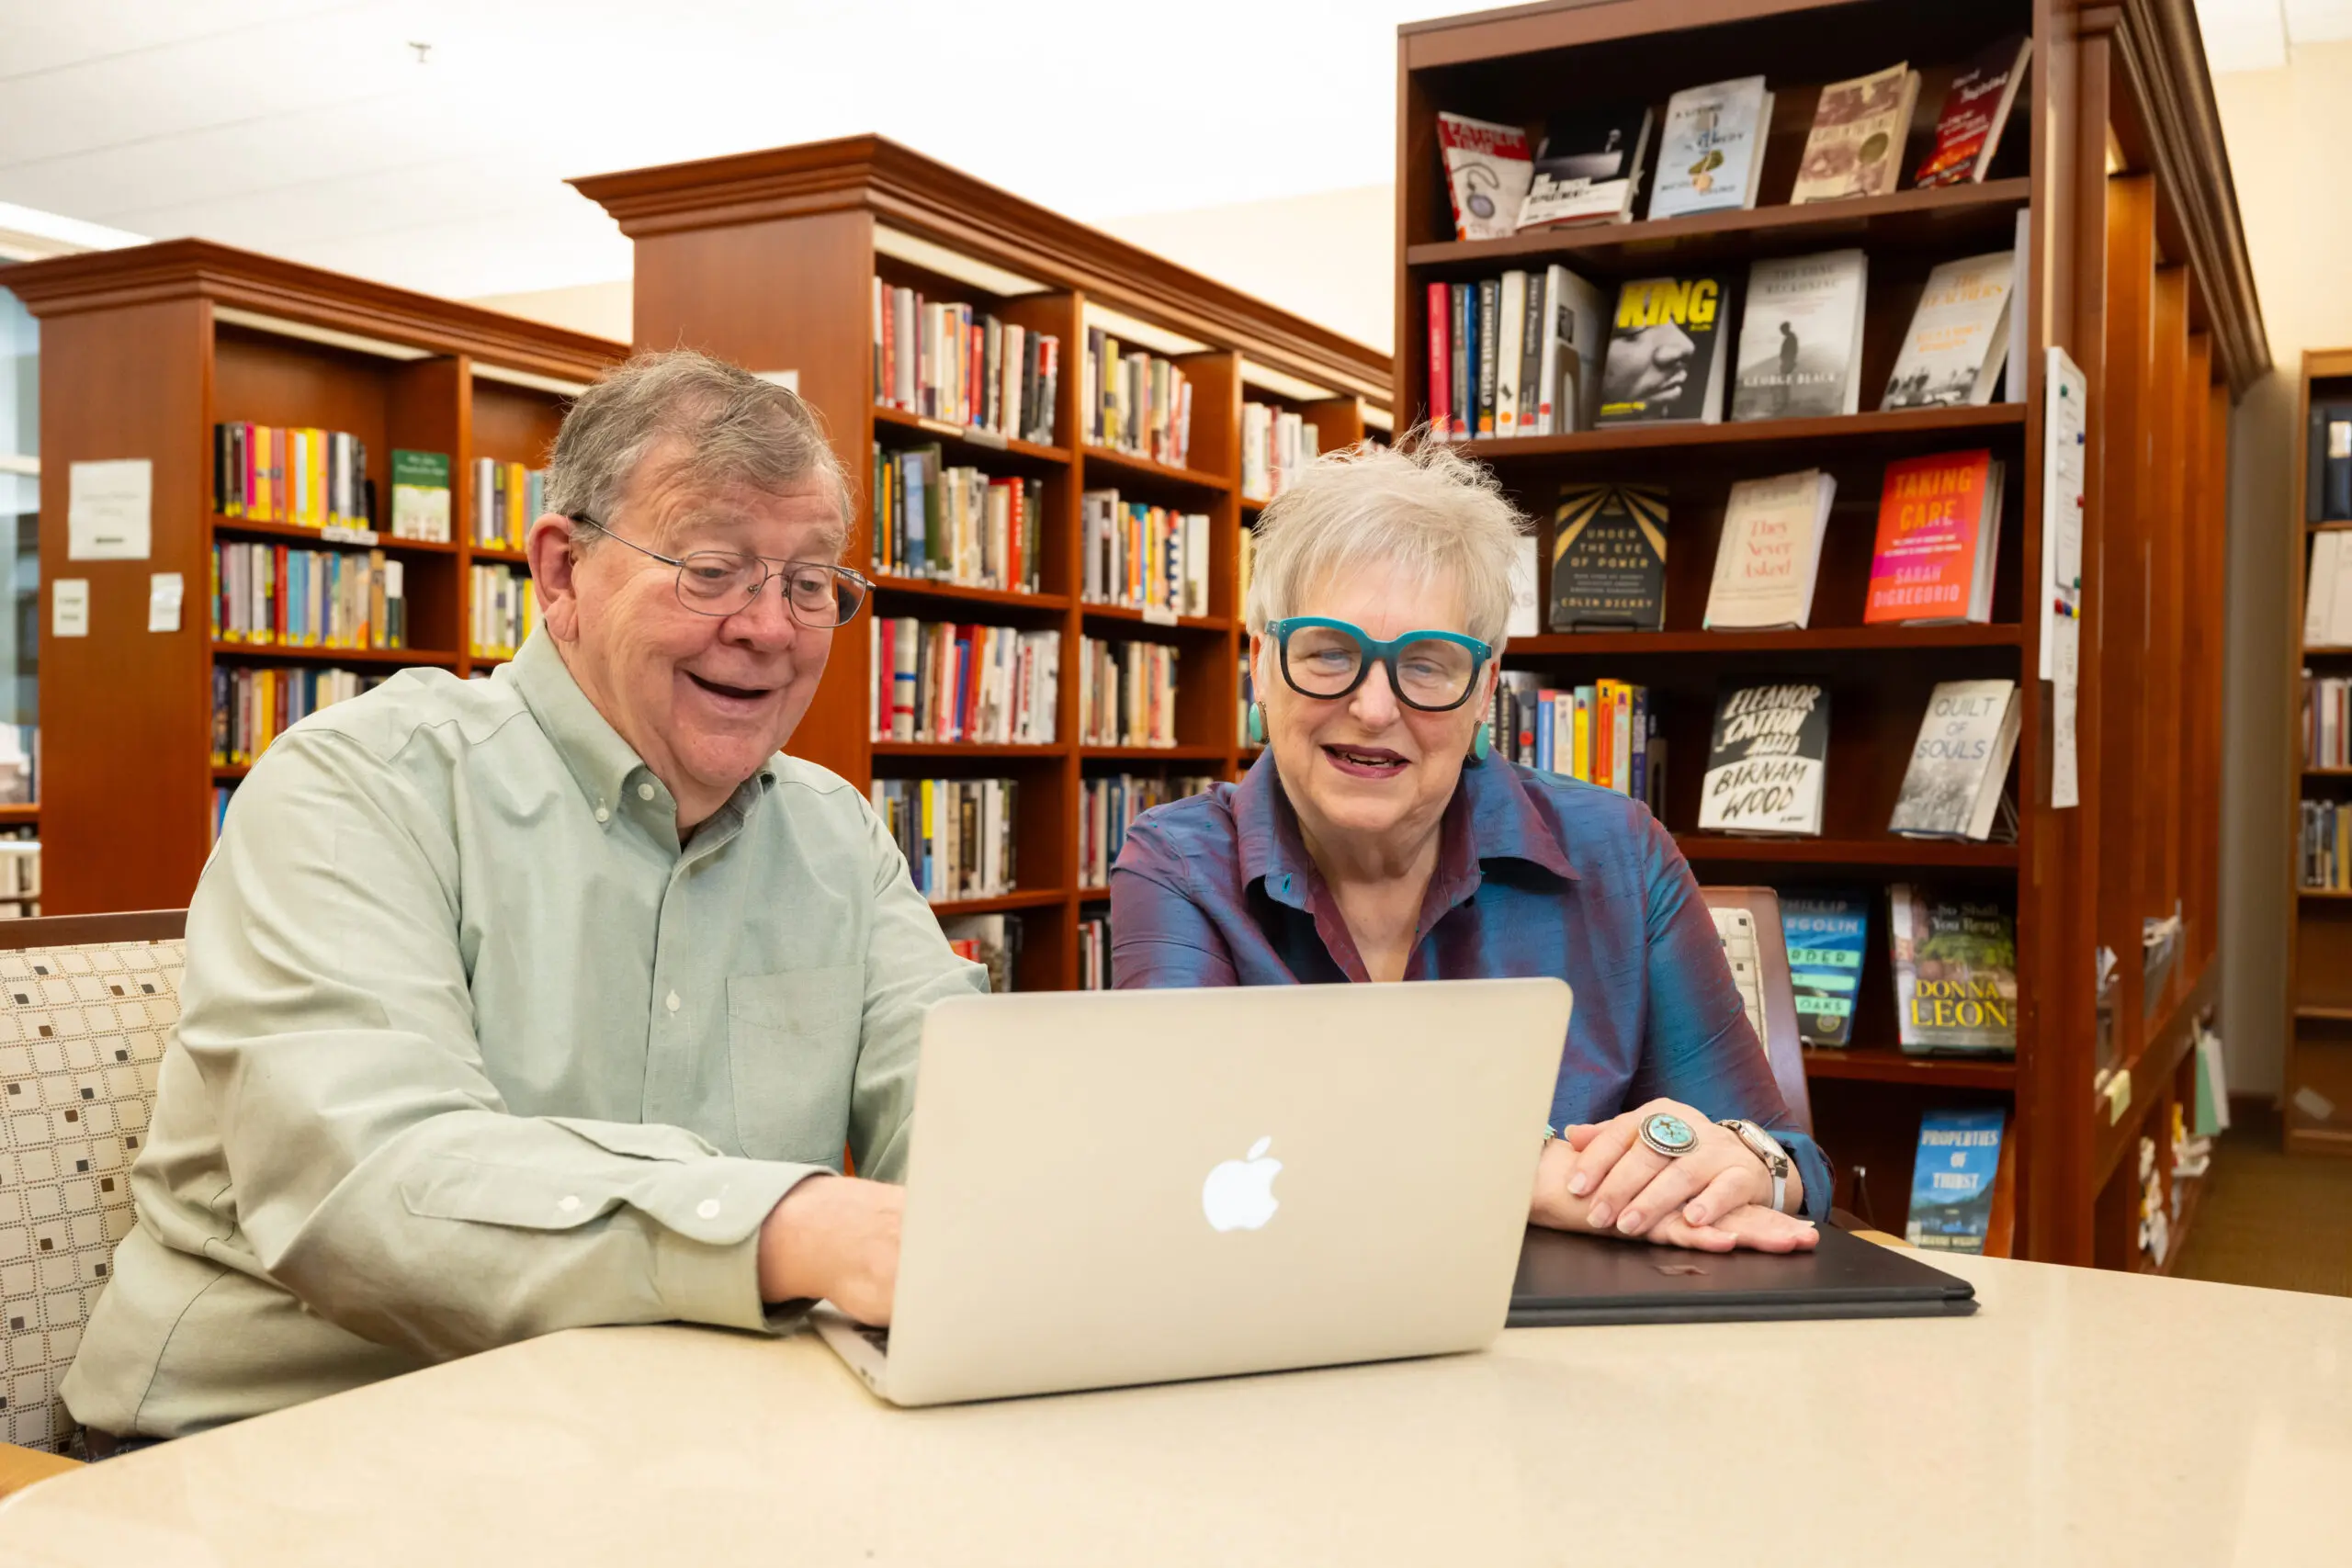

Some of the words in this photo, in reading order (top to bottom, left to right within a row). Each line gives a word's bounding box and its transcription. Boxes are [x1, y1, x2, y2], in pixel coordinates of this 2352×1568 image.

[1482, 286, 1495, 306] AN
[1617, 278, 1718, 328] KING
[1481, 306, 1494, 360] IMMENSE
[1480, 361, 1496, 407] WORLD
[1895, 467, 1973, 499] TAKING
[1899, 500, 1956, 531] CARE
[1586, 529, 1637, 540] UNDER
[1750, 520, 1788, 540] They
[1579, 543, 1607, 554] THE
[1614, 543, 1643, 555] EYE
[1747, 541, 1794, 557] Never
[1570, 557, 1589, 568] OF
[1598, 557, 1650, 569] POWER
[1745, 558, 1792, 579] Asked
[1894, 564, 1942, 585] SARAH
[1722, 684, 1823, 720] ELEANOR
[1934, 696, 1996, 718] QUILT
[1946, 720, 1969, 737] OF
[1916, 739, 1987, 761] SOULS
[1713, 760, 1809, 797] BIRNAM
[1720, 785, 1795, 822] WOOD
[1785, 918, 1860, 933] RGOLIN
[1931, 918, 1960, 932] You
[1792, 949, 1847, 964] RDER
[1916, 979, 2000, 1000] DONNA
[1799, 998, 1843, 1012] OAKS
[1911, 998, 2008, 1029] LEON
[1921, 1130, 2000, 1147] PROPERTIES
[1950, 1151, 1969, 1168] OF
[1932, 1172, 1980, 1190] THIRST
